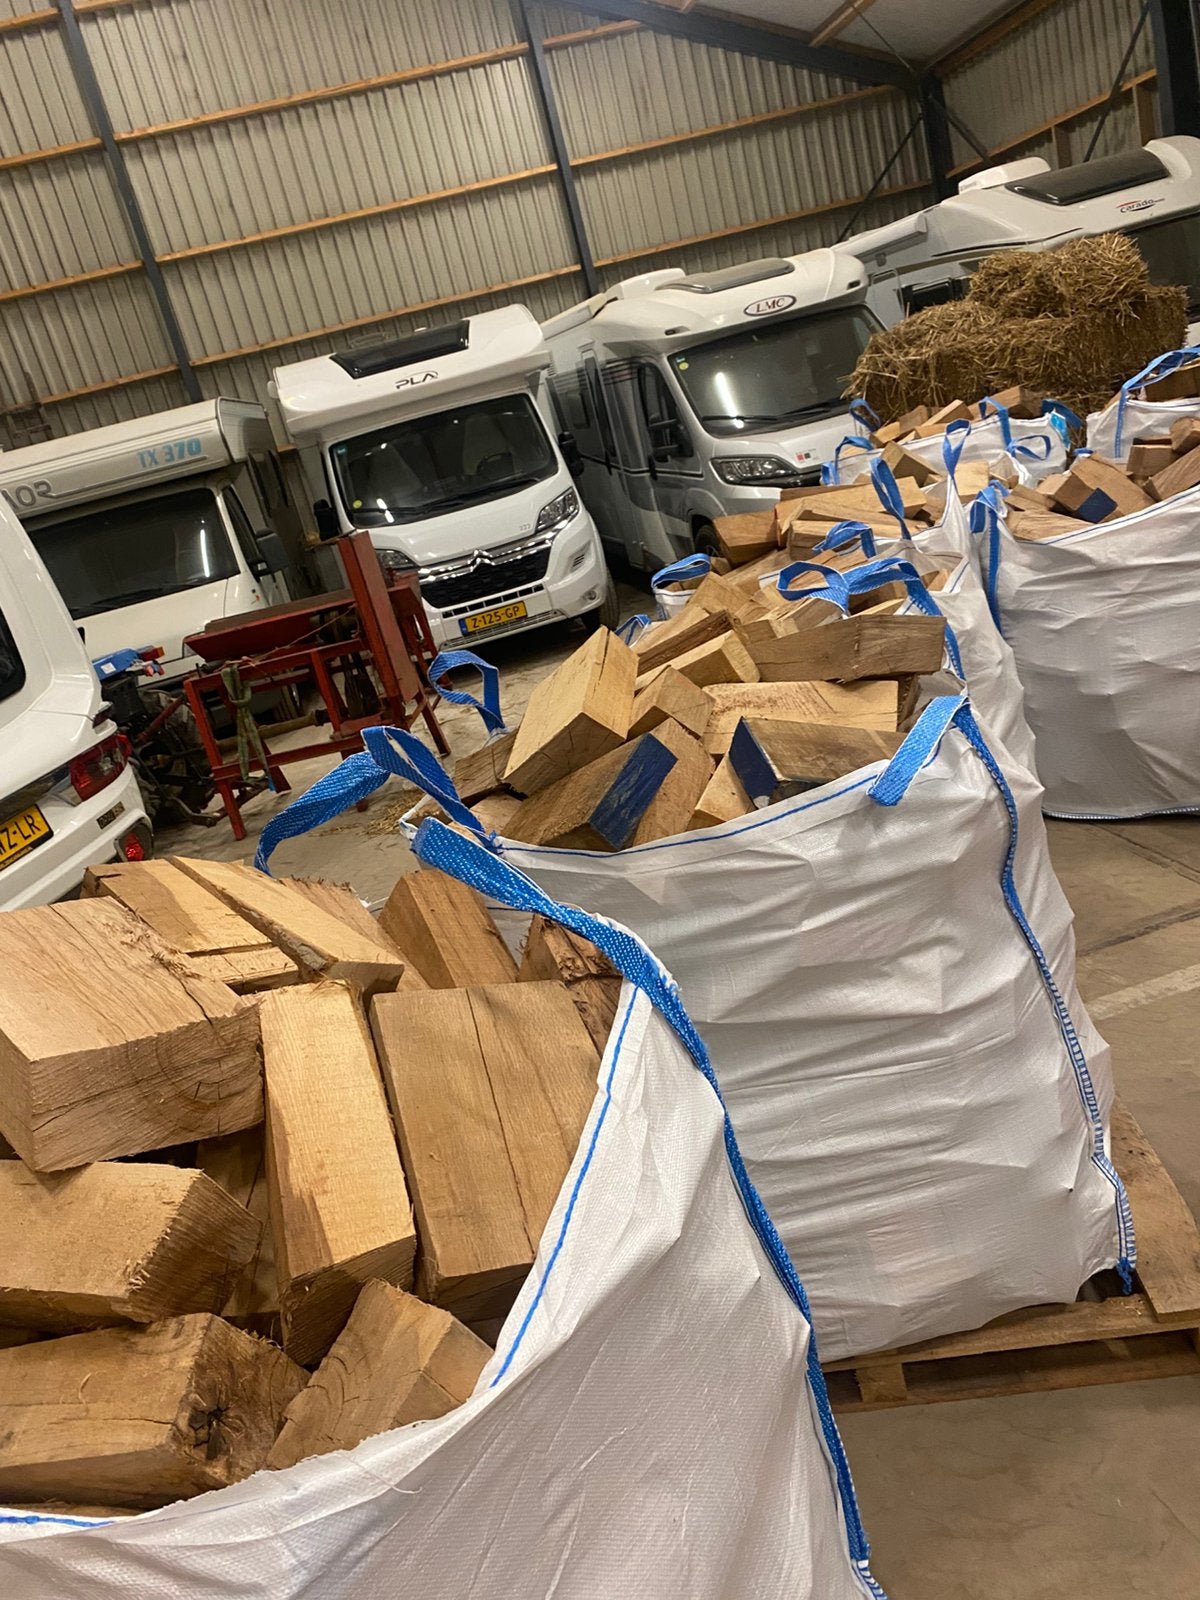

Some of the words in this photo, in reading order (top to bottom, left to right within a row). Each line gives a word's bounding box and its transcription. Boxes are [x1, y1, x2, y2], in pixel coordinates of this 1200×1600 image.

[1120, 199, 1154, 213] Carado
[757, 298, 785, 313] LMC
[395, 372, 435, 390] PLA
[137, 448, 159, 468] TX
[162, 437, 202, 463] 370
[471, 605, 520, 629] Z-125-GP
